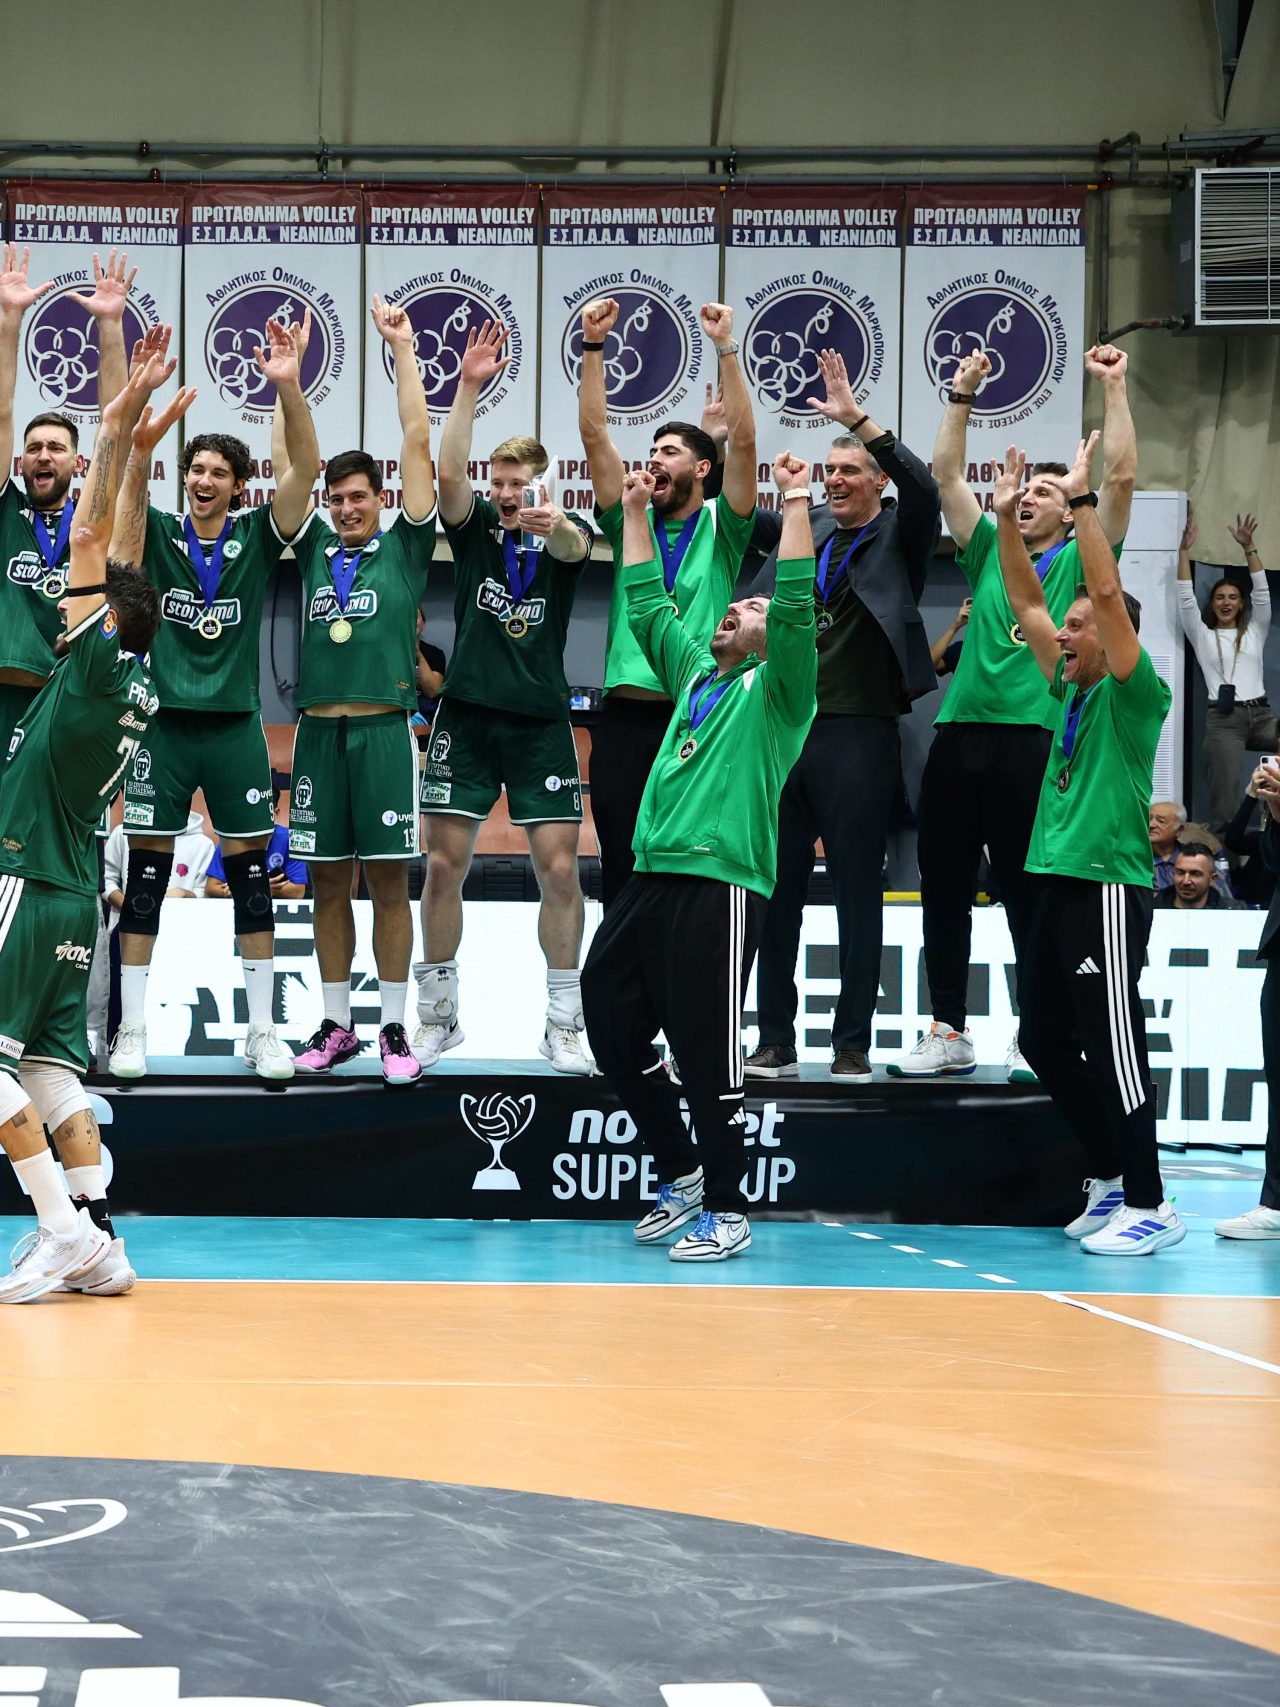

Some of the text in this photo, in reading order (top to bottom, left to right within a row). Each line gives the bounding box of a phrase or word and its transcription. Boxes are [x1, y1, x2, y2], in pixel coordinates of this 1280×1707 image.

[15, 204, 179, 224] ΠΡΩΤΑΘΛΗΜΑ VOLLEY
[192, 206, 356, 223] ΠΡΩΤΑΘΛΗΜΑ VOLLEY
[371, 207, 535, 224] ΠΡΩΤΑΘΛΗΜΑ VOLLEY
[549, 206, 716, 224] ΠΡΩΤΑΘΛΗΜΑ VOLLEY
[733, 208, 897, 226] ΠΡΩΤΑΘΛΗΜΑ VOLLEY
[914, 207, 1081, 225] ΠΡΩΤΑΘΛΗΜΑ VOLLEY
[15, 224, 178, 244] Ε.Σ.Π.Α.Α.Α. ΝΕΑΝΙΔΩΝ
[192, 226, 356, 243] Ε.Σ.Π.Α.Α.Α. ΝΕΑΝΙΔΩΝ
[371, 227, 534, 244] Ε.Σ.Π.Α.Α.Α. ΝΕΑΝΙΔΩΝ
[549, 226, 715, 245] Ε.Σ.Π.Α.Α.Α. ΝΕΑΝΙΔΩΝ
[732, 229, 897, 246] Ε.Σ.Π.Α.Α.Α. ΝΕΑΝΙΔΩΝ
[913, 228, 1080, 245] Ε.Σ.Π.Α.Α.Α. ΝΕΑΝΙΔΩΝ
[926, 272, 989, 310] ΑΘΛΗΤΙΚΟΣ
[994, 269, 1039, 299] ΟΜΙΛΟΣ
[206, 270, 267, 307] ΑΘΛΗΤΙΚΟΣ
[272, 266, 317, 297] ΟΜΙΛΟΣ
[315, 292, 345, 381] ΜΑΡΚΟΠΟΥΛΟΥ
[450, 268, 495, 298] ΟΜΙΛΟΣ
[494, 293, 523, 382] ΜΑΡΚΟΠΟΥΛΟΥ
[744, 273, 806, 310] ΑΘΛΗΤΙΚΟΣ
[812, 270, 857, 300] ΟΜΙΛΟΣ
[856, 295, 885, 384] ΜΑΡΚΟΠΟΥΛΟΥ
[562, 268, 702, 426] ΑΘΛΗΤΙΚΟΣ ΟΜΙΛΟΣ ΜΑΡΚΟΠΟΥΛΟΥ ΕΤΟΣ ΙΔΡΥΣΕΩΣ 198
[1038, 294, 1067, 384] ΜΑΡΚΟΠΟΥΛΟΥ
[1032, 388, 1052, 409] ΕΤΟΣ
[779, 415, 801, 428] 1988
[987, 406, 1032, 429] ΙΔΡΥΣΕΩΣ
[573, 792, 580, 811] 8
[552, 1153, 796, 1202] SUPE UP
